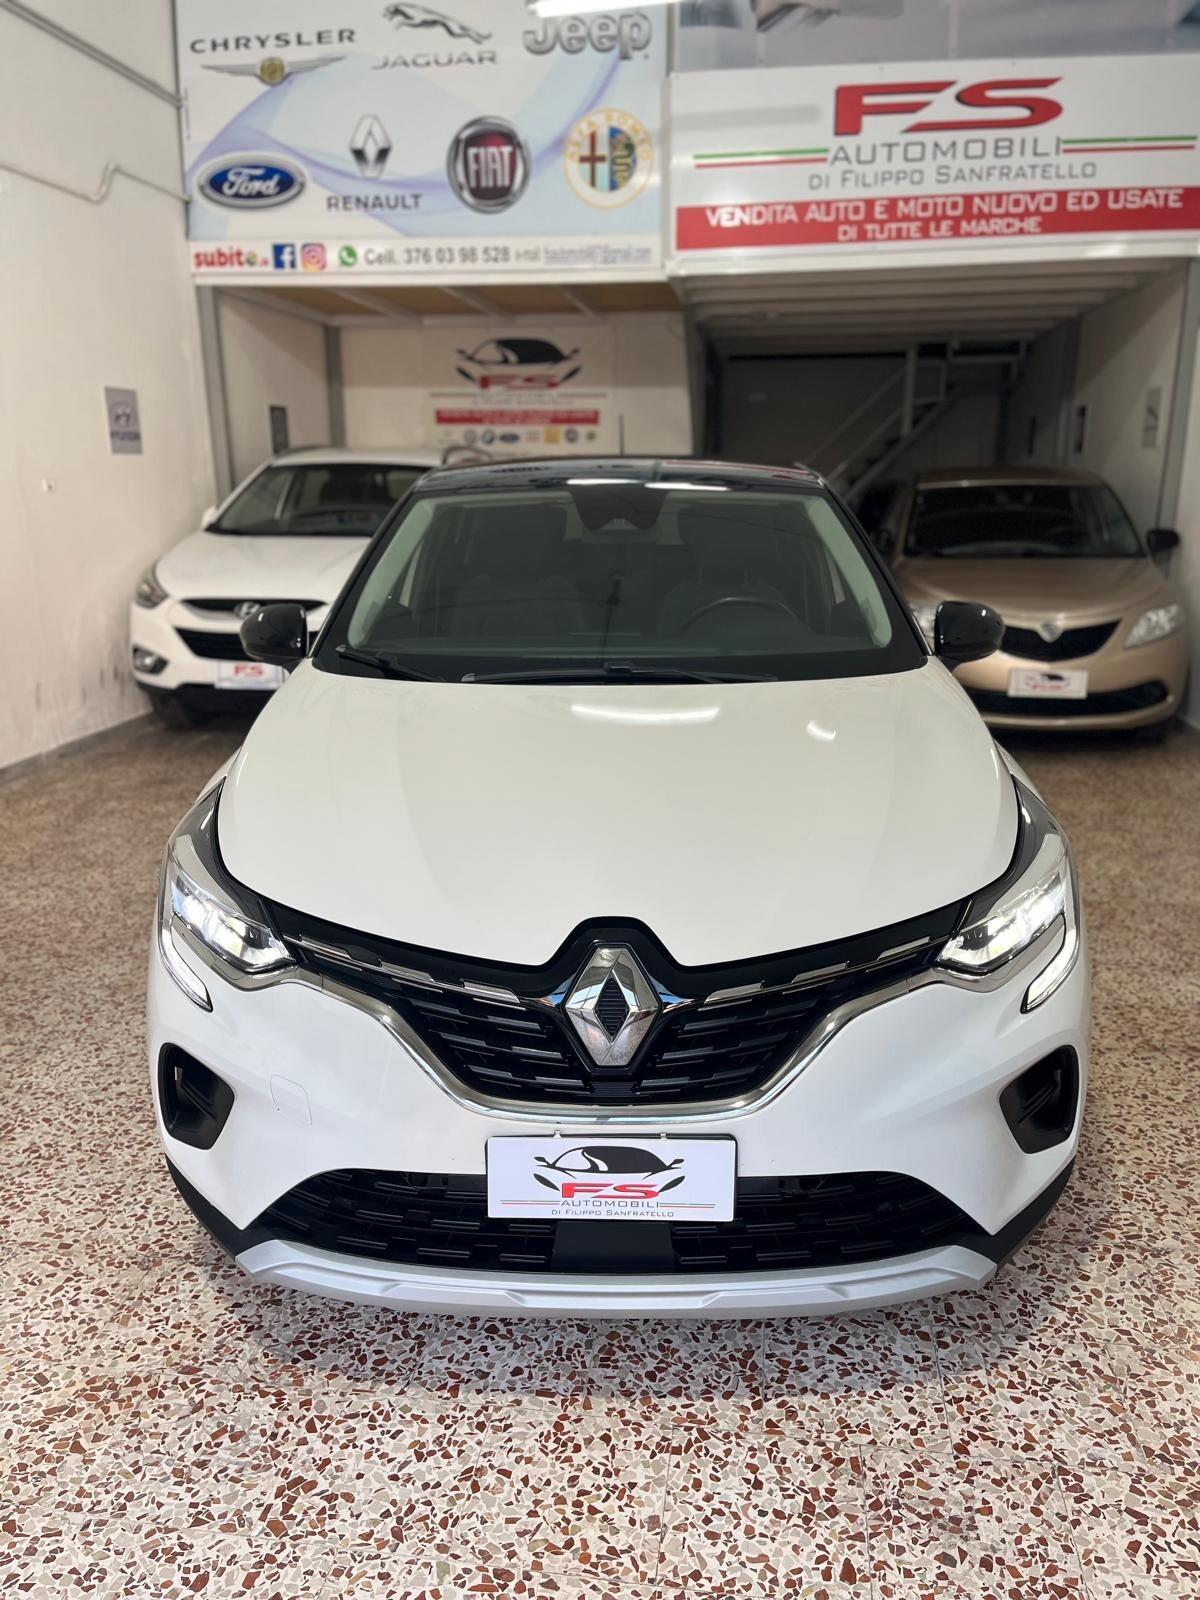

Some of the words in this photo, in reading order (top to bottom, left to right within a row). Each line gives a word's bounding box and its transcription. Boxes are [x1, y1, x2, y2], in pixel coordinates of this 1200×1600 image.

[190, 29, 356, 54] CHRYSLER
[523, 13, 652, 60] Jeep
[372, 50, 498, 70] JAGUAR
[834, 77, 1064, 136] FS
[829, 136, 1061, 166] AUTOMOBILI
[466, 145, 516, 189] FIAT
[221, 165, 280, 197] Ford
[809, 173, 830, 190] DI
[326, 194, 423, 212] RENAULT
[705, 205, 798, 228] VENDITA
[805, 202, 867, 223] AUTO
[874, 200, 889, 219] E
[897, 196, 964, 218] MOTO
[974, 193, 1058, 214] NUOVO
[1066, 190, 1100, 211] ED
[1107, 188, 1184, 210] USATE
[837, 224, 857, 241] DI
[864, 222, 922, 240] TUTTE
[929, 219, 952, 237] LE
[960, 216, 1042, 236] MARCHE
[364, 248, 399, 265] Cell.
[403, 246, 432, 264] 376
[435, 246, 457, 263] 03
[460, 246, 480, 263] 98
[483, 245, 511, 262] 528
[562, 1183, 659, 1199] FS
[560, 1200, 659, 1209] AUTOMOBILI
[606, 1209, 674, 1217] SANFRATELLO
